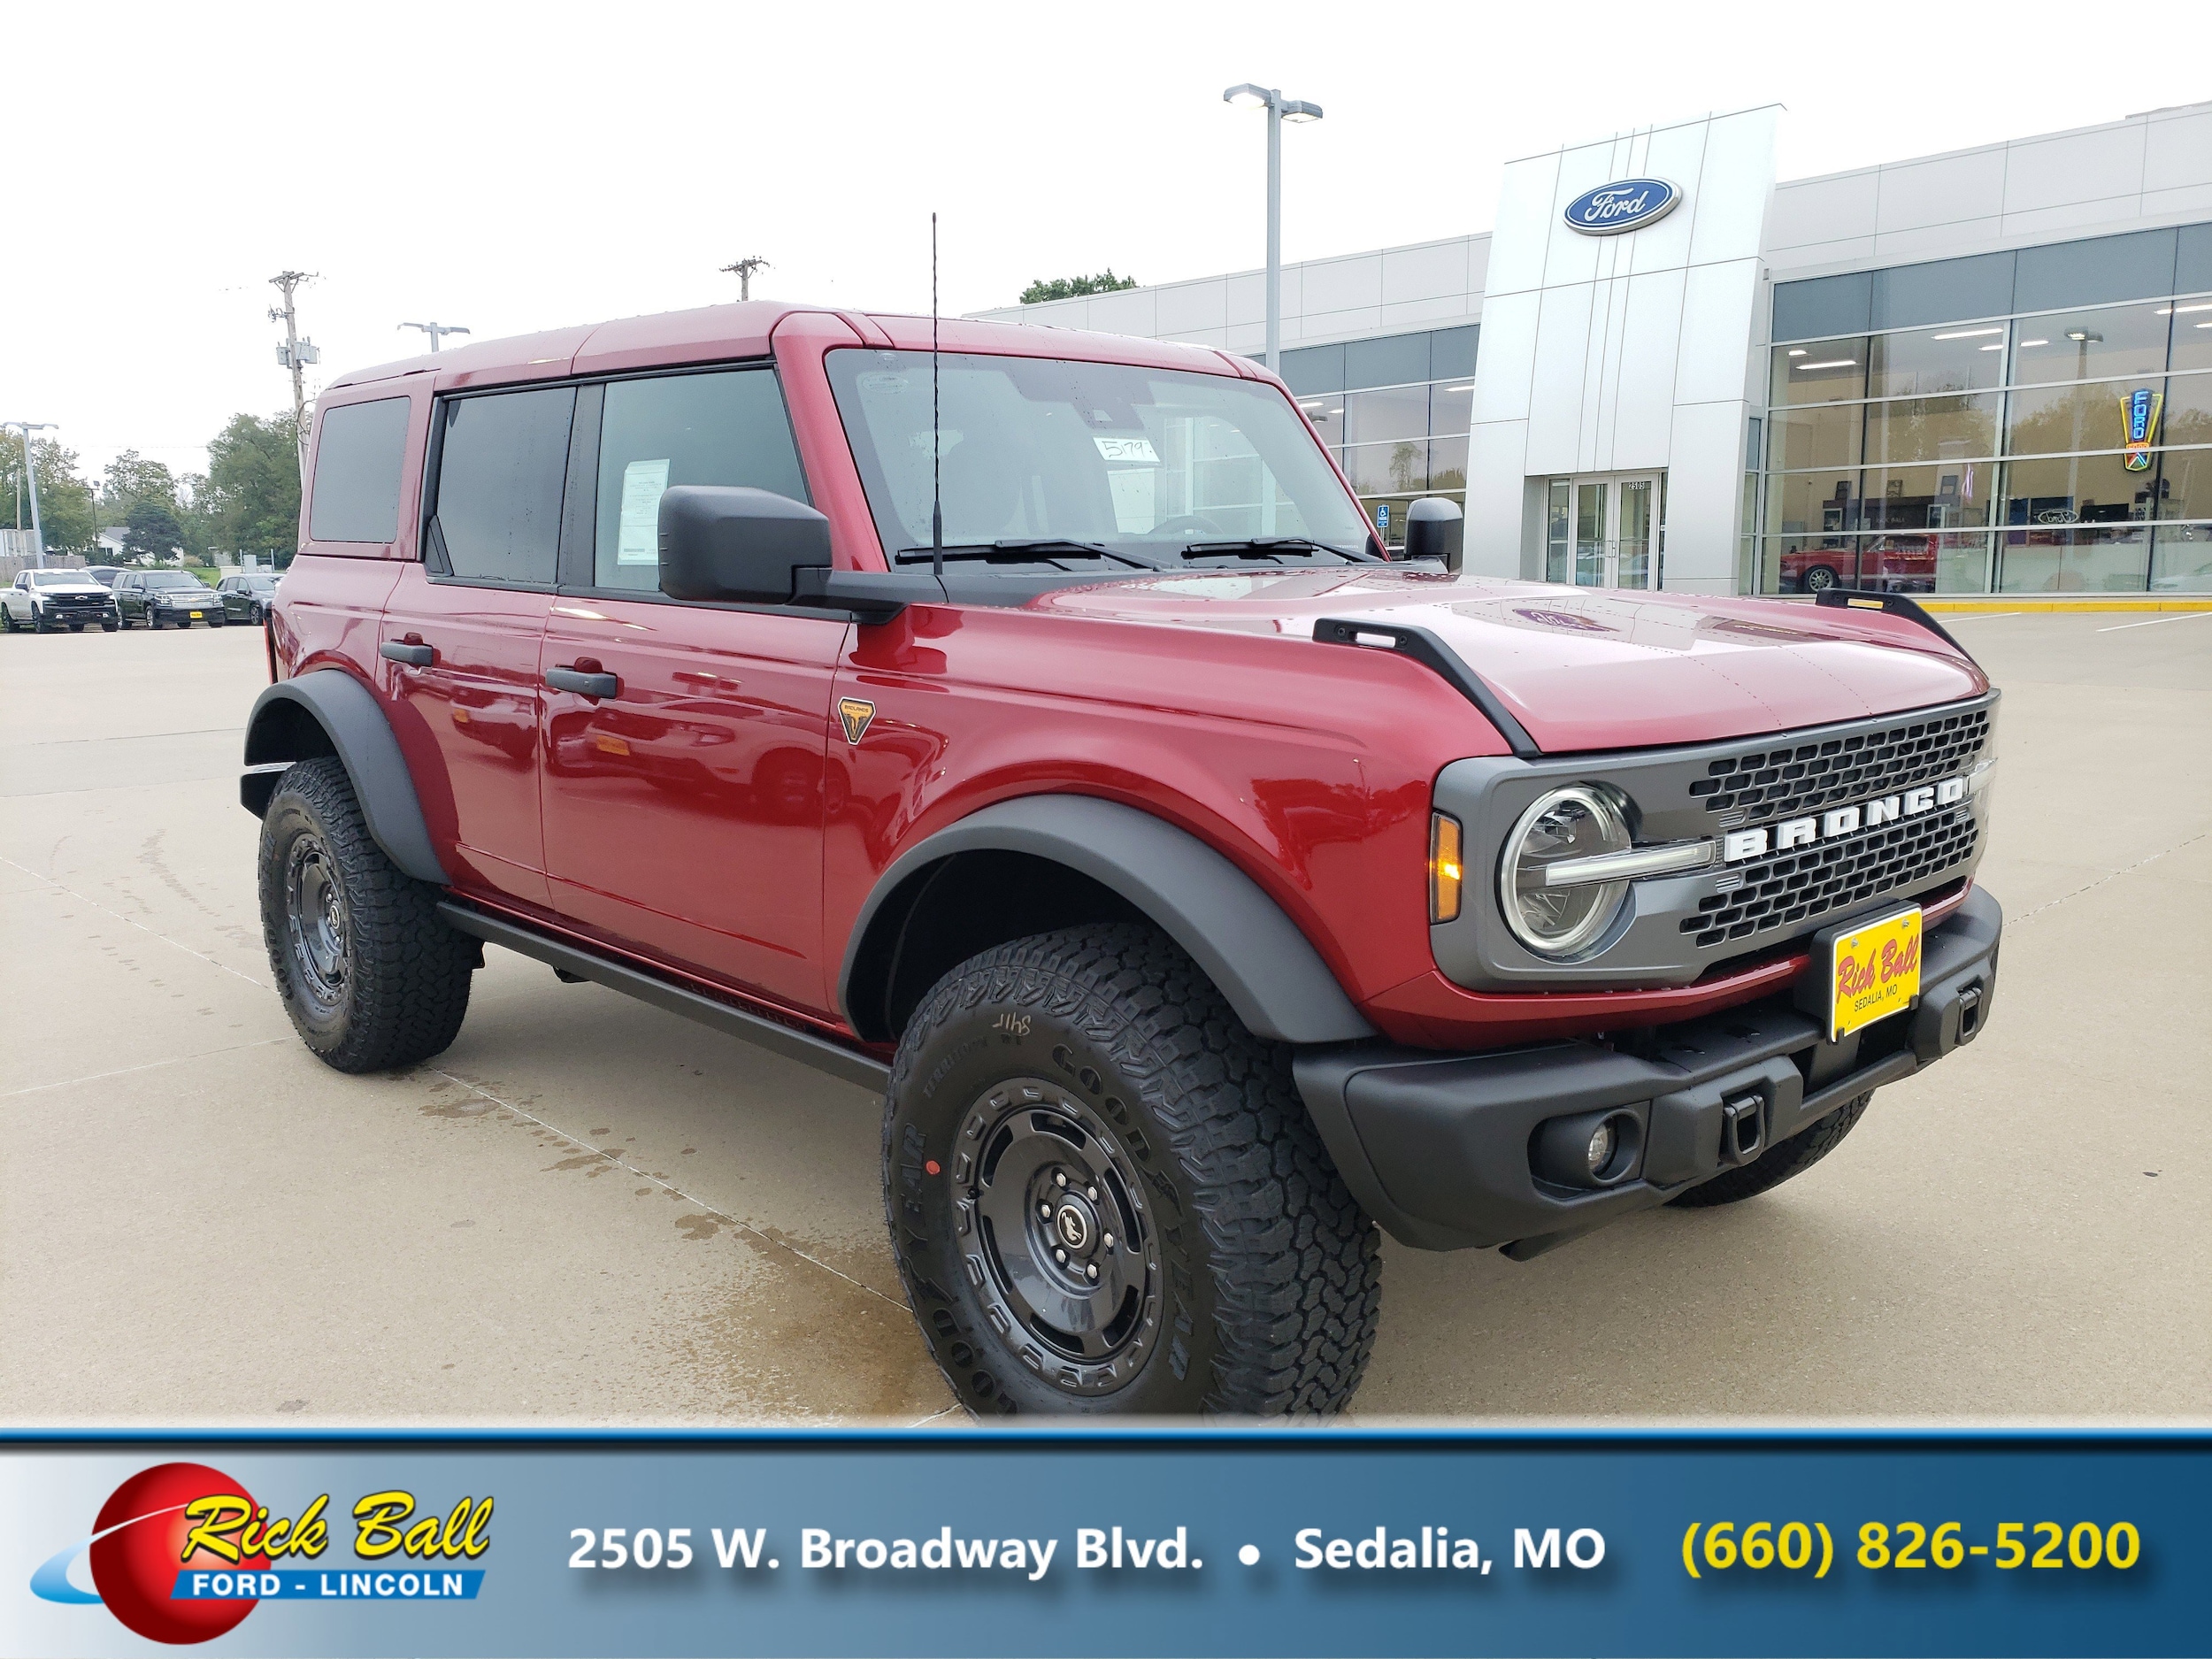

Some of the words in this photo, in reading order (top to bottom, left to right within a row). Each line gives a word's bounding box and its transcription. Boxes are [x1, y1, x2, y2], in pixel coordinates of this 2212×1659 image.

[1584, 187, 1649, 222] Ford
[2133, 390, 2149, 440] FORD
[1101, 440, 1146, 458] 5179
[1628, 481, 1645, 490] 2505
[844, 704, 869, 713] BADLANDS
[1724, 776, 1963, 863] BRONCO
[1836, 948, 1877, 1004] Rick
[1880, 933, 1919, 984] Ball
[1855, 989, 1885, 1012] SEDALIA,
[1886, 984, 1898, 998] MO
